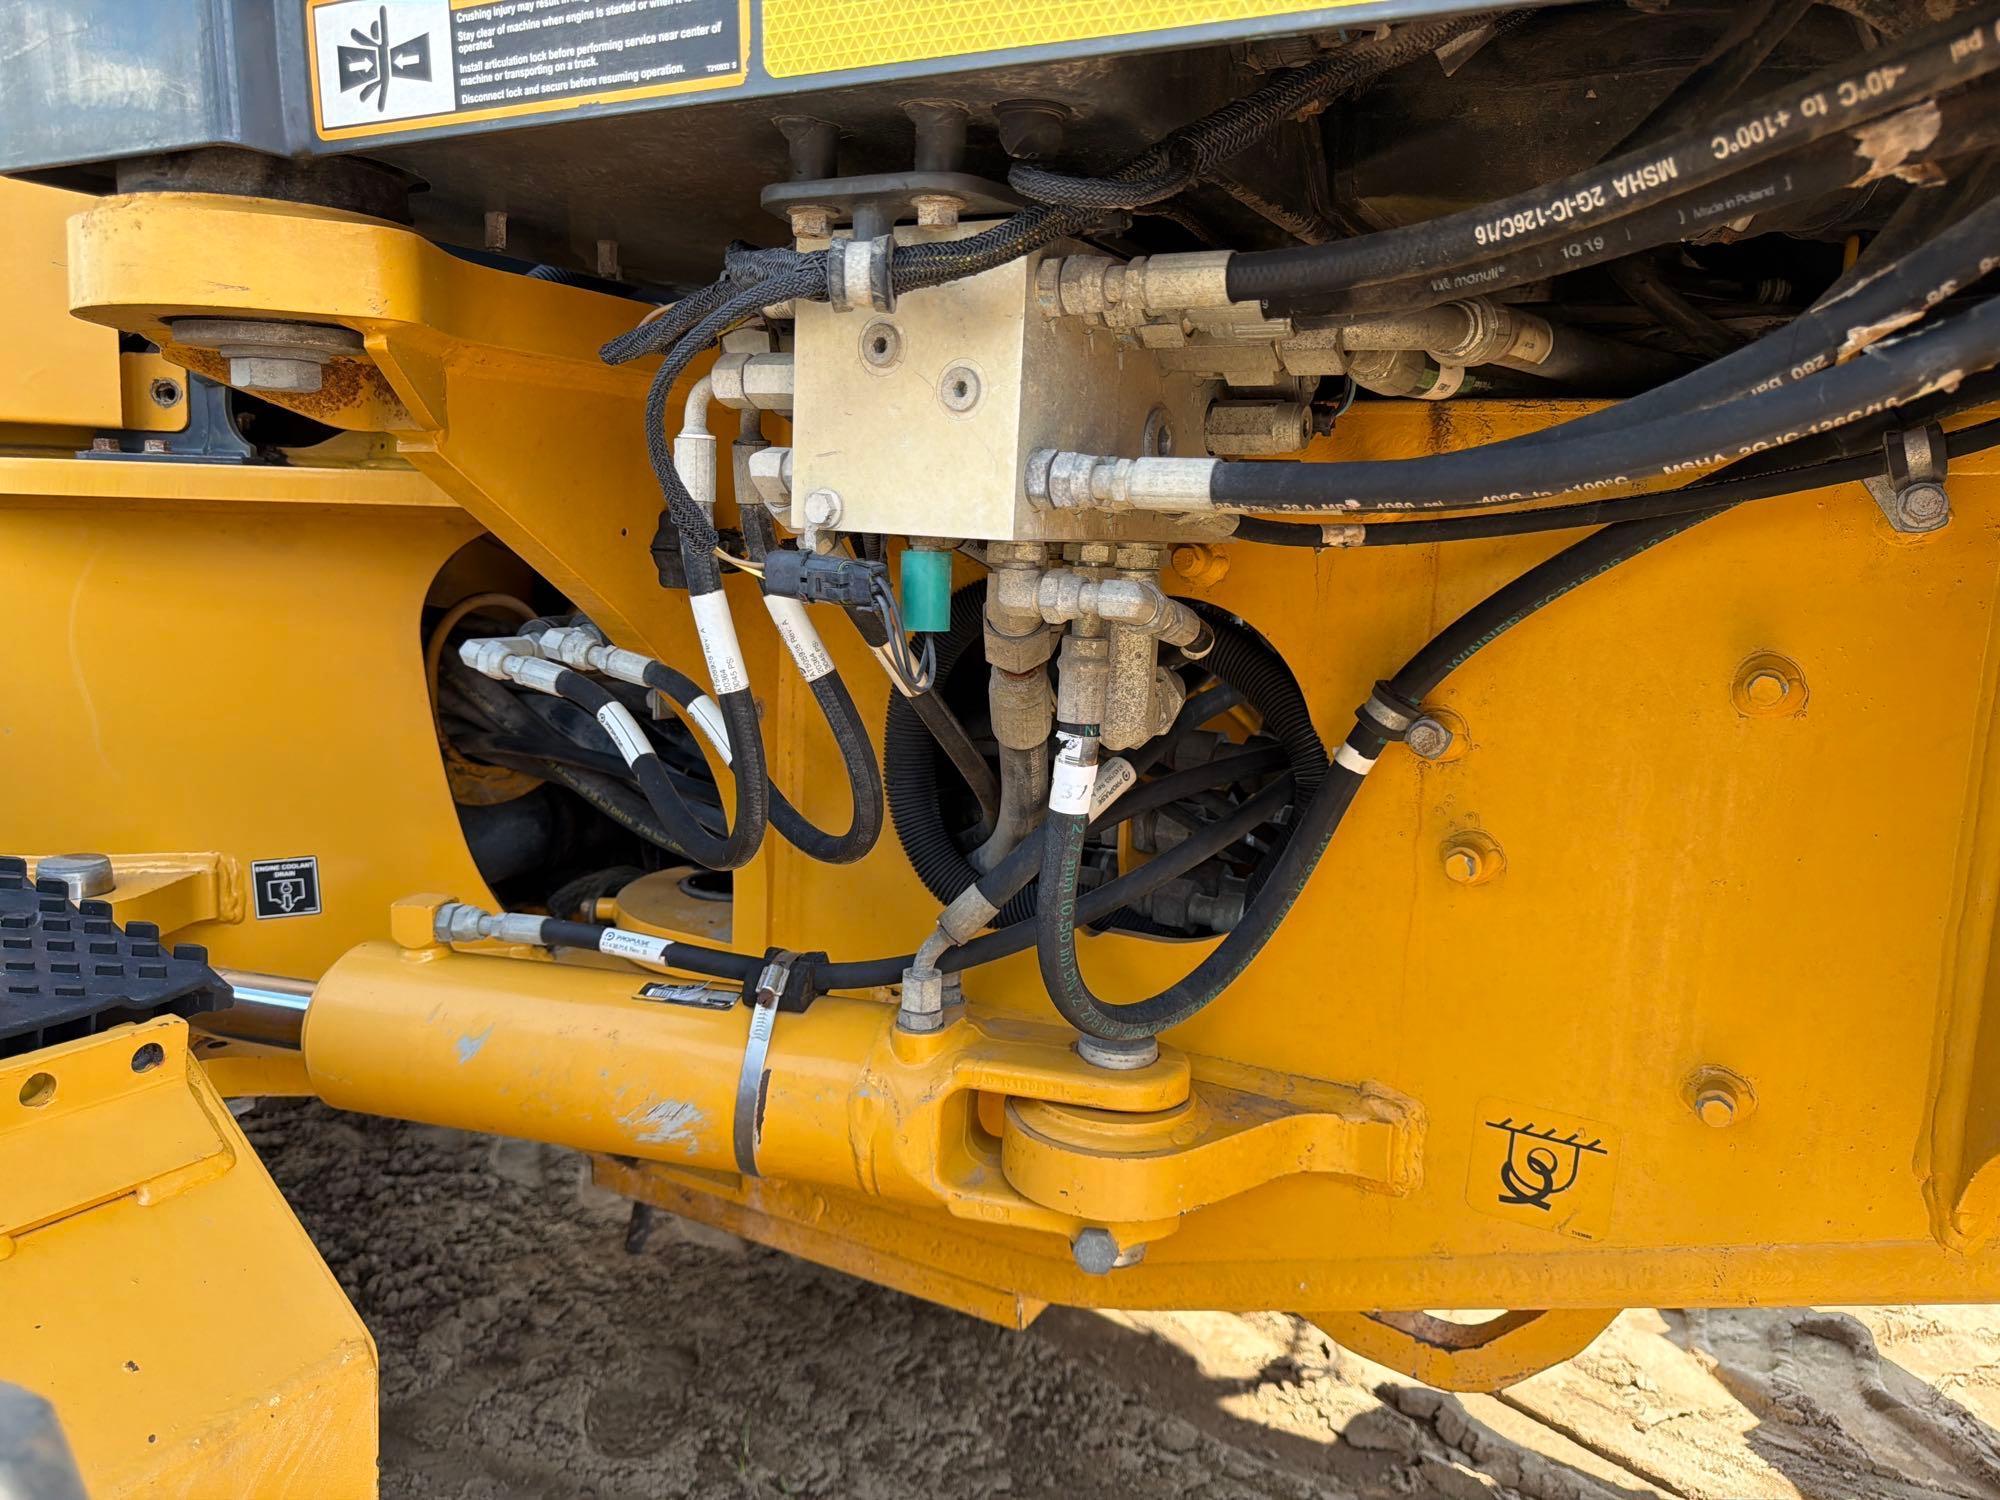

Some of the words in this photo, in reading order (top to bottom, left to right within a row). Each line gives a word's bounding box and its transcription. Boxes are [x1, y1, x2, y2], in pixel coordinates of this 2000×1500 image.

[456, 9, 492, 23] Crushing
[493, 5, 516, 18] injury
[517, 2, 534, 12] may
[457, 30, 475, 42] Stay
[476, 27, 495, 39] clear
[497, 23, 506, 35] of
[507, 19, 540, 33] machine
[542, 15, 564, 27] when
[566, 9, 594, 24] engine
[596, 7, 604, 18] is
[605, 2, 636, 16] started
[637, 1, 648, 11] or
[458, 39, 495, 55] operated.
[459, 58, 483, 73] Install
[484, 54, 529, 70] articulation
[529, 49, 547, 63] lock
[548, 46, 575, 60] before
[577, 40, 623, 57] performing
[625, 34, 656, 48] service
[658, 30, 679, 42] near
[680, 25, 710, 39] center
[711, 20, 722, 34] of
[460, 72, 493, 87] machine
[494, 71, 503, 81] or
[504, 63, 554, 80] transporting
[554, 62, 566, 72] on
[566, 60, 573, 70] a
[574, 56, 599, 69] truck.
[461, 90, 505, 104] Disconnect
[505, 86, 523, 99] lock
[524, 84, 540, 96] and
[540, 81, 569, 93] secure
[570, 76, 597, 89] before
[598, 70, 639, 84] resuming
[640, 64, 686, 80] operation.
[1800, 93, 1828, 118] to
[1711, 109, 1791, 160] +100°C
[1612, 156, 1679, 198] MSHA
[1474, 185, 1606, 245] 2G-IC-126C/16
[809, 652, 824, 674] 20364
[818, 652, 831, 670] 3045
[1097, 779, 1123, 804] PROPULSE
[255, 864, 280, 873] ENGINE
[281, 861, 313, 870] COOLANT
[273, 870, 296, 878] DRAIN
[1063, 859, 1076, 892] mm
